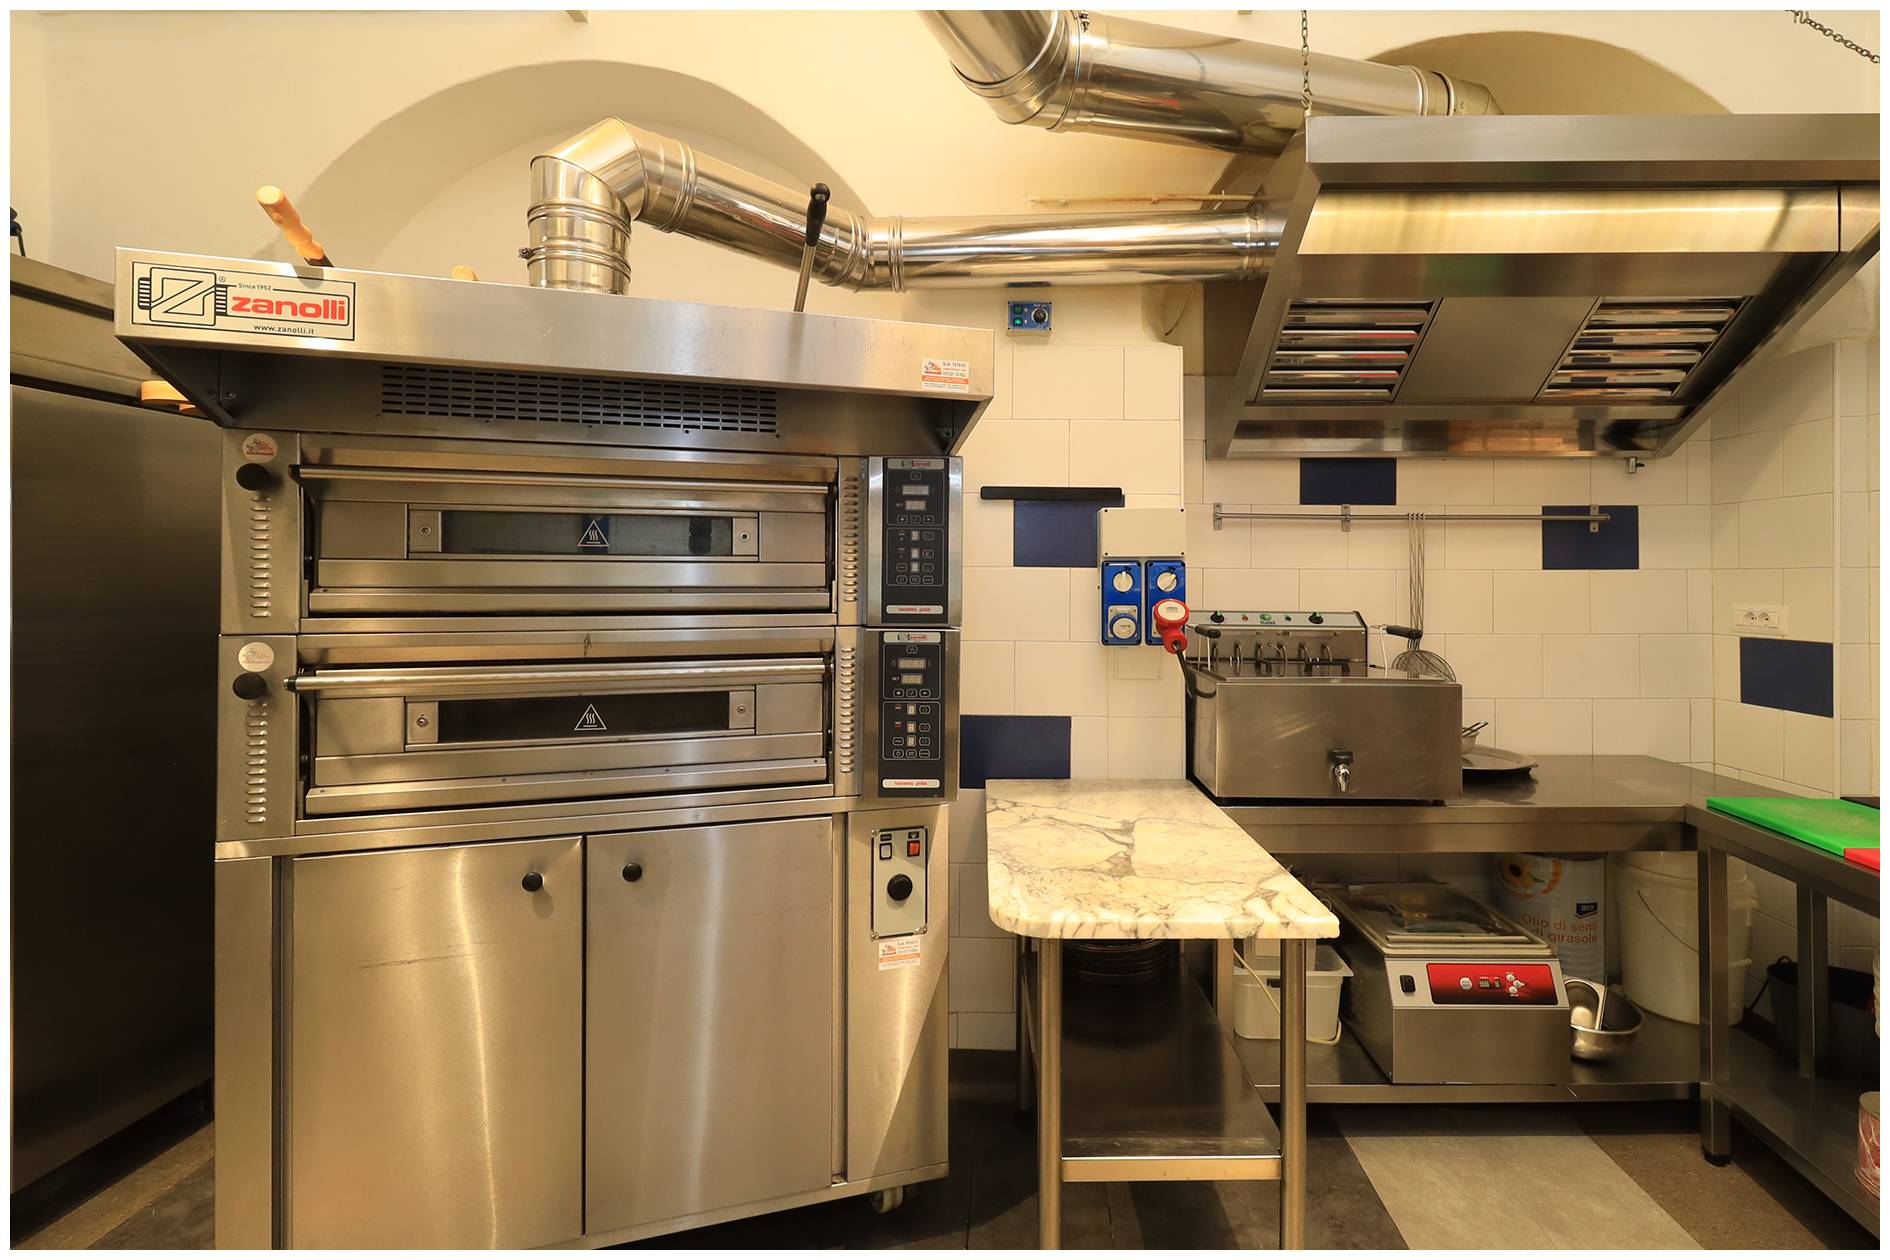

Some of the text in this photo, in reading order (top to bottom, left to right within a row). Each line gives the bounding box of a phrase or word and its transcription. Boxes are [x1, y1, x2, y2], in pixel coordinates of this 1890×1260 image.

[231, 296, 345, 320] zanolli
[253, 325, 315, 335] www.zanolli.it
[1521, 913, 1598, 932] Olio di semi
[1548, 932, 1598, 943] girasole
